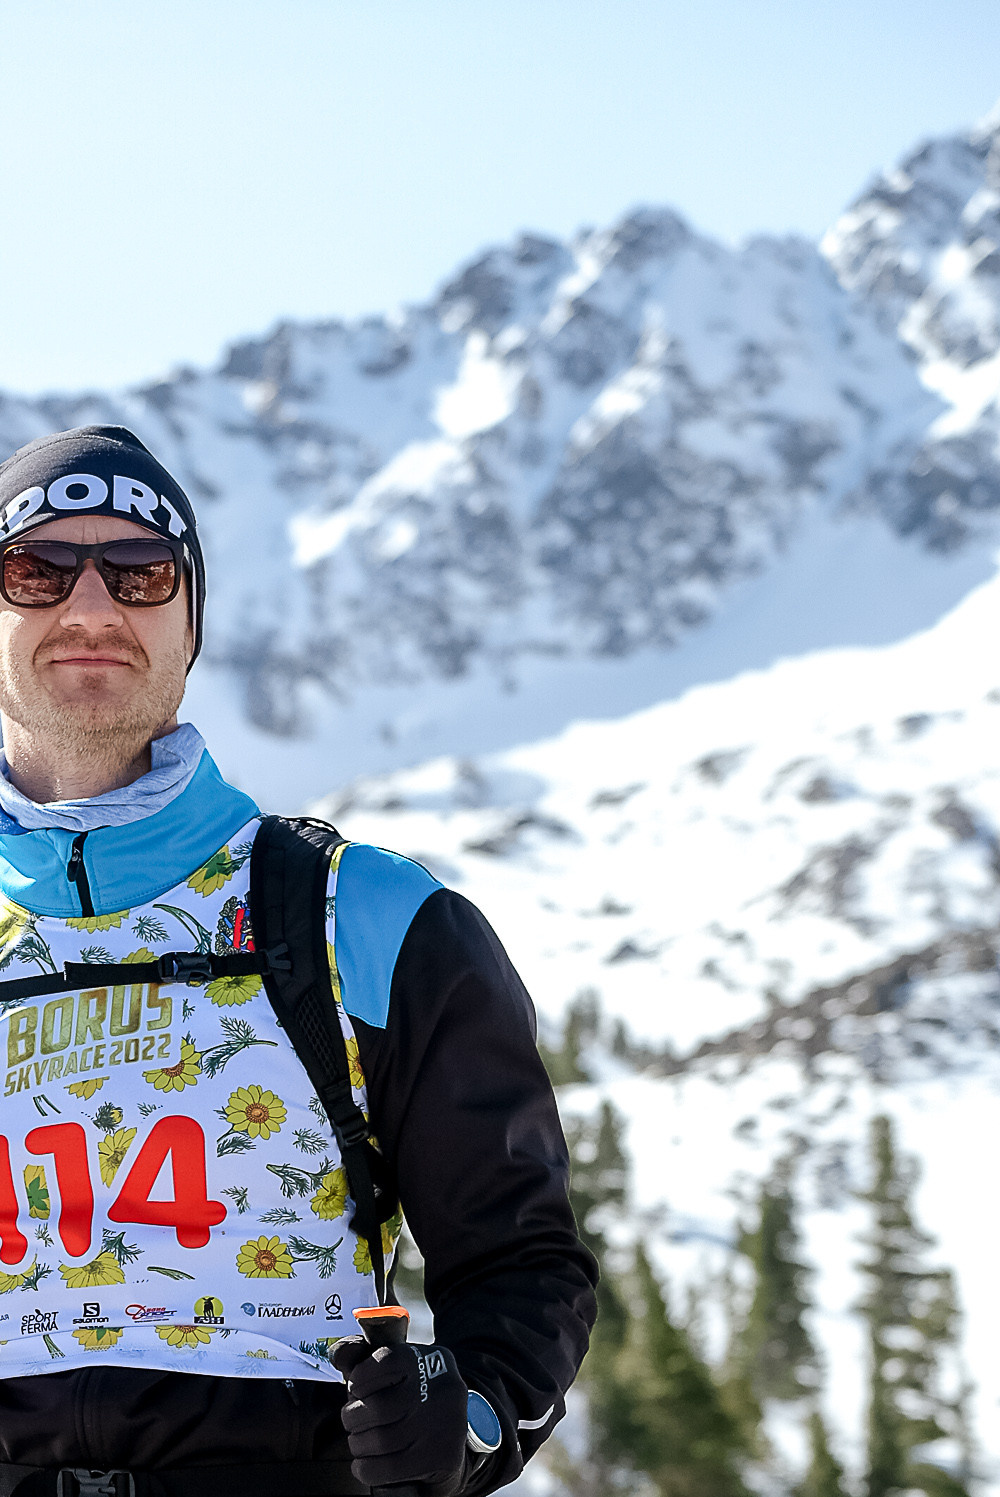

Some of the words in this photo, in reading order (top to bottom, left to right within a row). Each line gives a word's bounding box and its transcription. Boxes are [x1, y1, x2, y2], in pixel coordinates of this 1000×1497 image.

[6, 981, 173, 1068] BORUS
[21, 1309, 59, 1326] SPORT
[20, 1321, 59, 1335] FERMA
